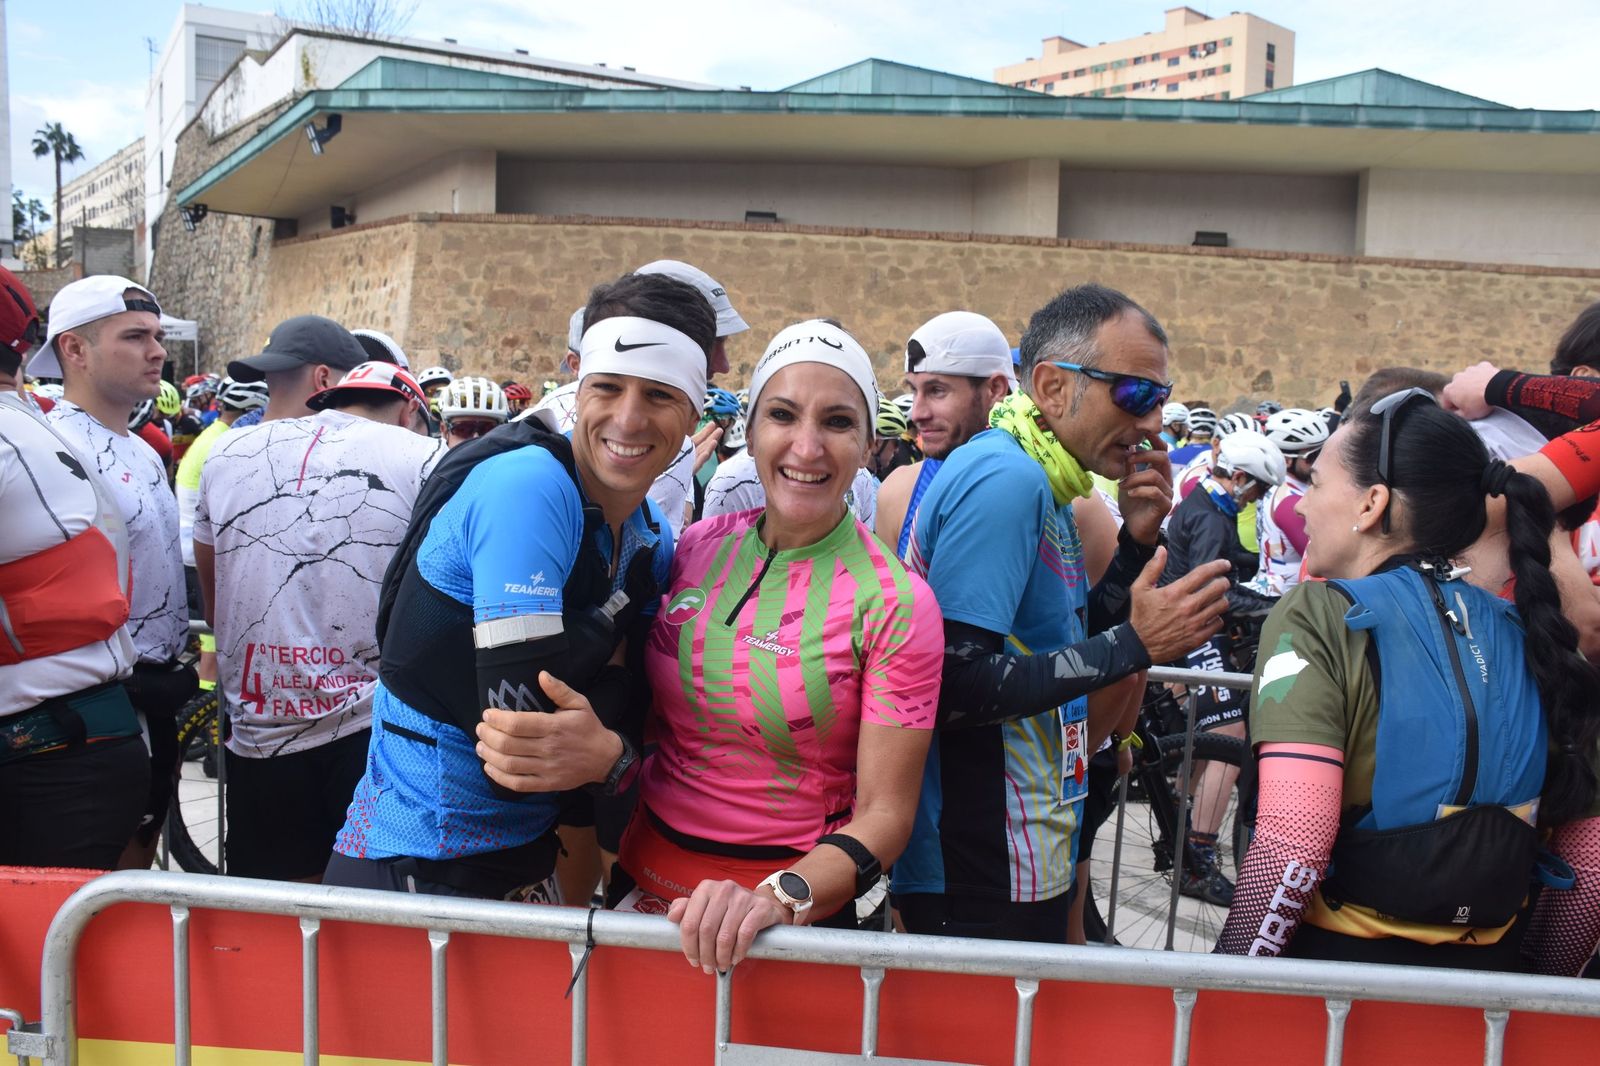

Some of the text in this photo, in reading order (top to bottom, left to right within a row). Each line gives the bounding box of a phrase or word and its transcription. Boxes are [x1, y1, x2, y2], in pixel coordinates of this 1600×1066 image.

[504, 583, 560, 597] TEAMERGY
[268, 645, 345, 665] TERCIO
[742, 635, 795, 656] TEAMERGY
